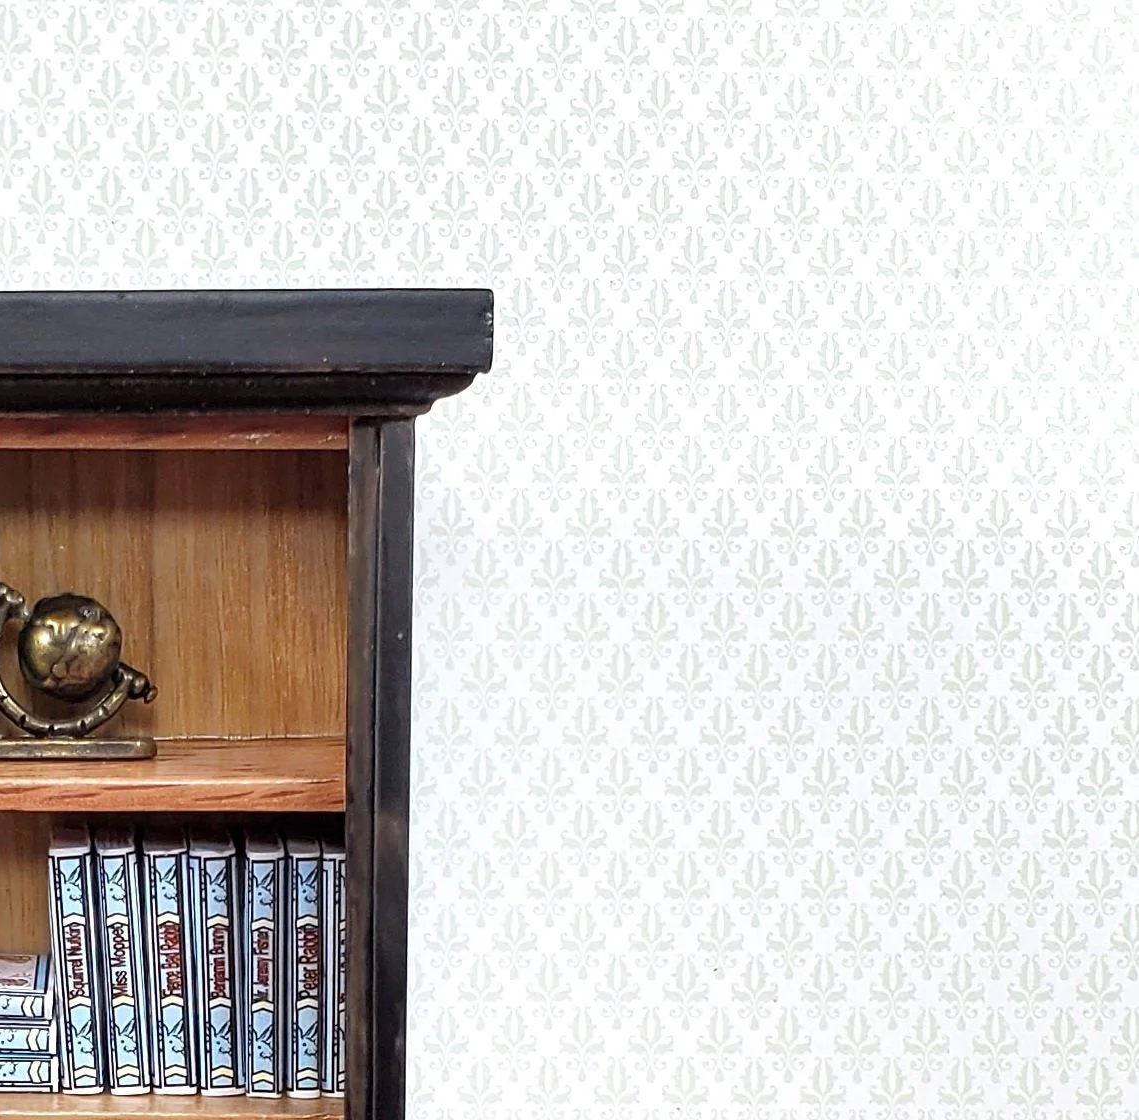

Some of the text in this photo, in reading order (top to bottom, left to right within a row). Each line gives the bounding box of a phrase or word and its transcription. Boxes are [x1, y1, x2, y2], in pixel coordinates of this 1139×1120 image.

[65, 924, 89, 996] Squirrel Nutkin
[109, 924, 129, 998] Miss Moppet
[161, 953, 180, 969] Bad
[209, 957, 229, 998] Benjamin
[298, 926, 318, 999] Peter Rabbit
